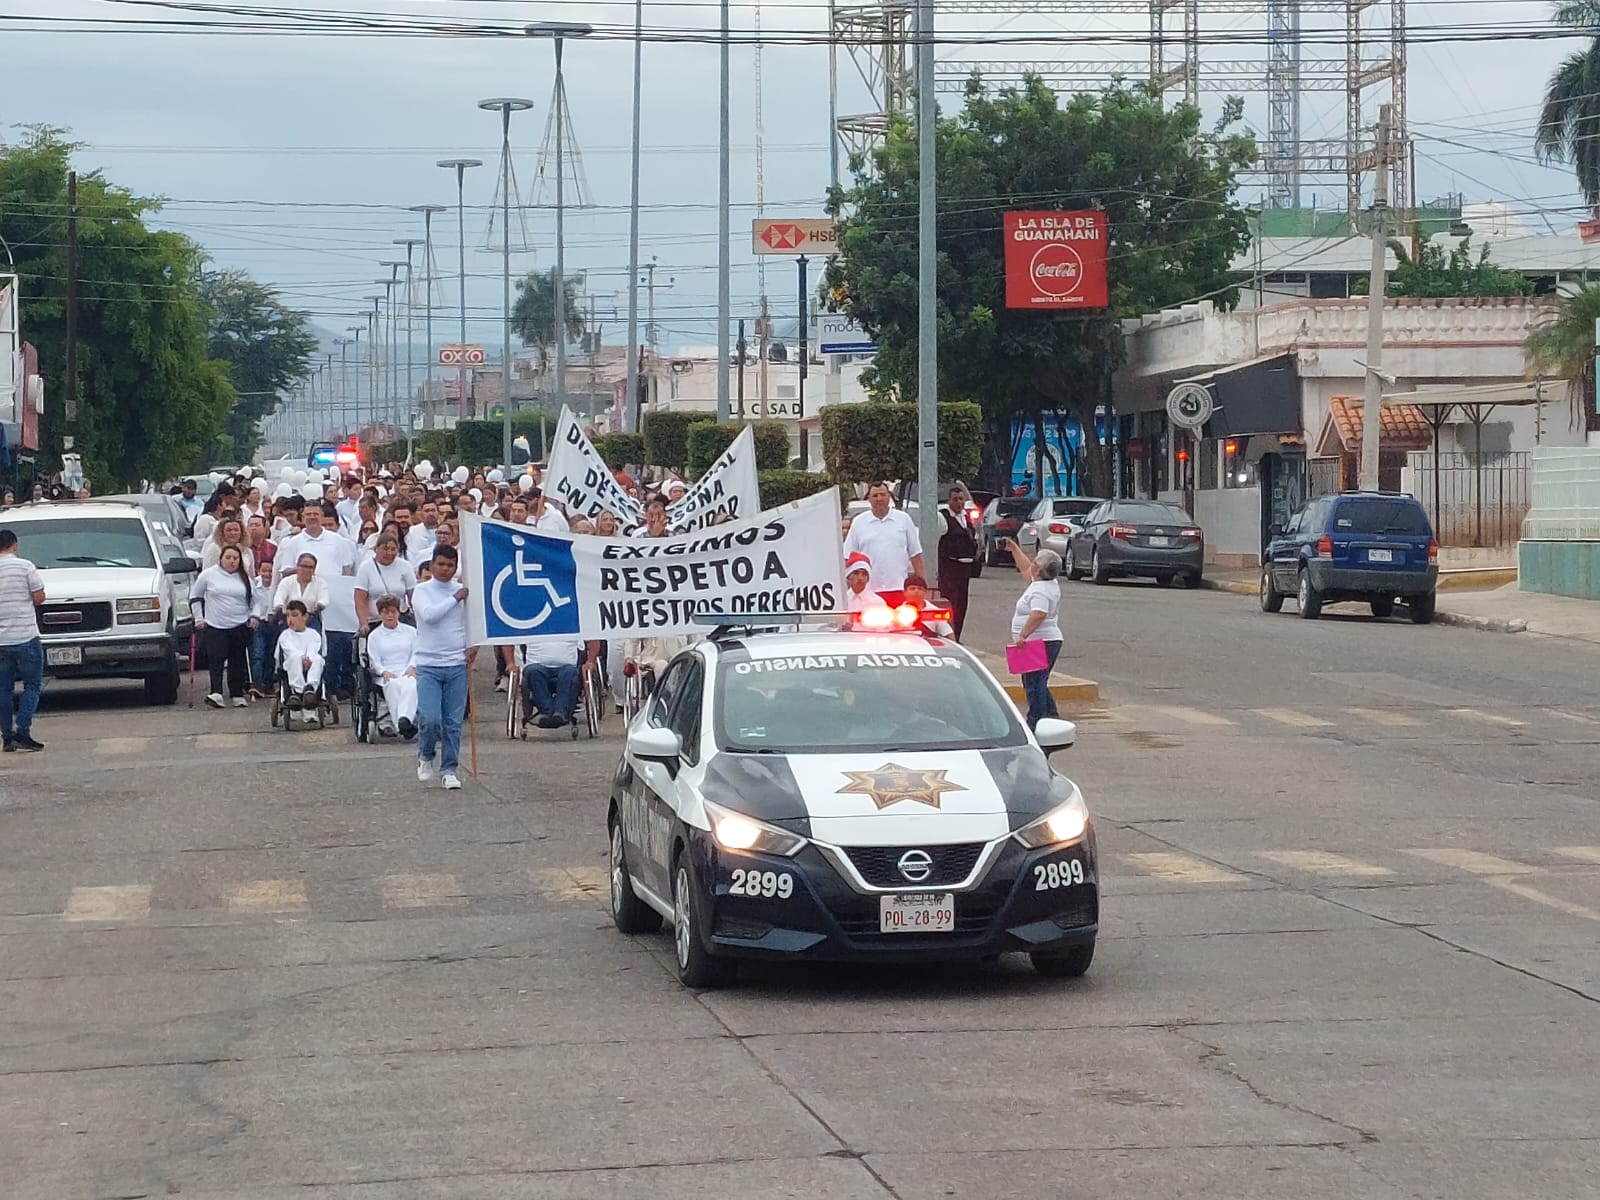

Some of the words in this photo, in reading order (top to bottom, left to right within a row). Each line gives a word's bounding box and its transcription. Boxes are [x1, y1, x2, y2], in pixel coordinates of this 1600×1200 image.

[1018, 219, 1037, 229] LA
[1040, 217, 1072, 229] ISLA
[1075, 217, 1095, 228] DE
[810, 230, 837, 242] HSB
[1014, 228, 1099, 241] GUANAHANI
[751, 403, 787, 415] CSA
[603, 520, 786, 560] EXIGIMOS
[600, 556, 754, 594] RESPETO
[762, 551, 788, 580] A
[728, 868, 793, 899] 2899
[1033, 858, 1084, 891] 2899
[885, 909, 952, 927] POL-28-99
